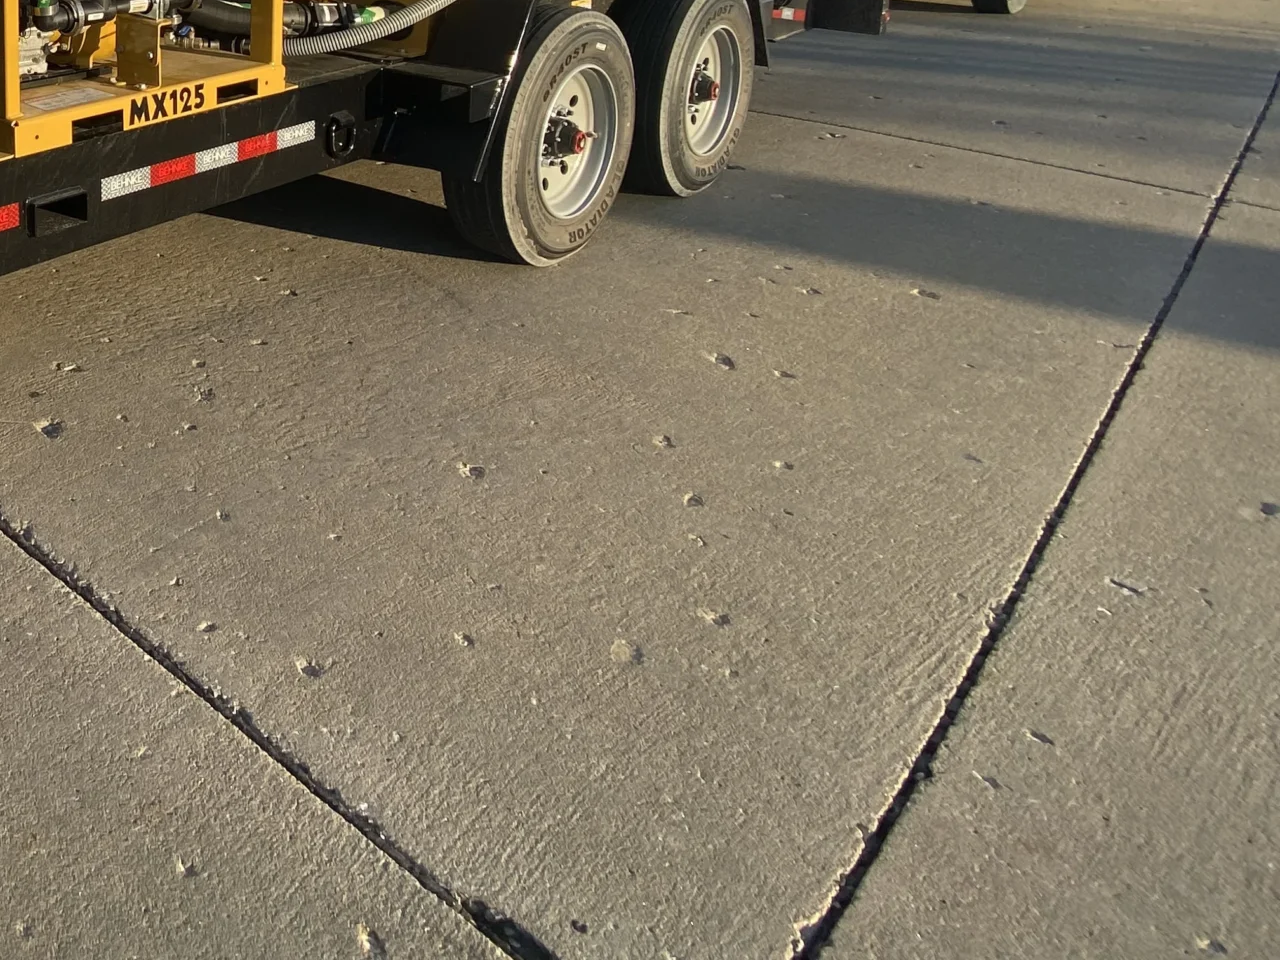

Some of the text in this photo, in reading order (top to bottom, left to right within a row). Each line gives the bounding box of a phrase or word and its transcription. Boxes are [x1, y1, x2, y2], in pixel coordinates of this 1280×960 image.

[128, 83, 206, 126] MX125
[203, 148, 232, 163] BEHNKE
[110, 174, 143, 191] BEHNKE
[568, 160, 625, 244] GLADIATOR
